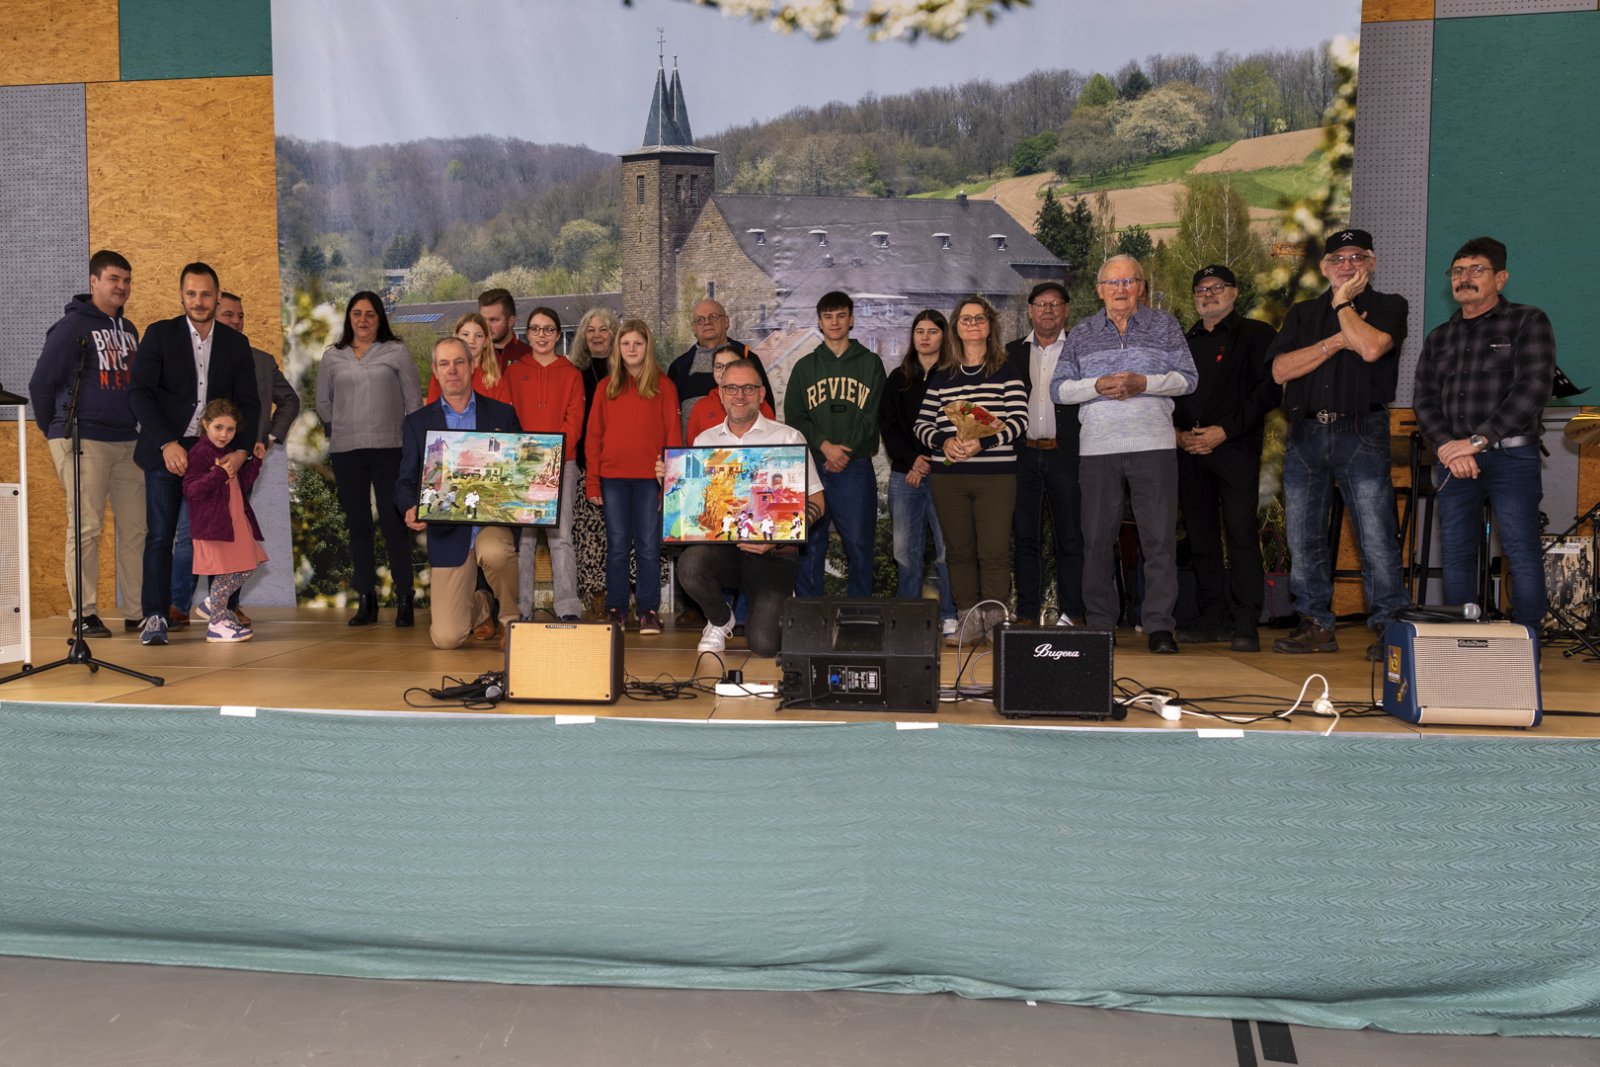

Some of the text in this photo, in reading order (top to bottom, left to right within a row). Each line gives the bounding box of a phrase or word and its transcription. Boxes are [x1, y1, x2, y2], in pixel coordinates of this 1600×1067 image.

[97, 350, 128, 371] NYC
[806, 376, 871, 410] REVIEW
[1033, 643, 1080, 660] Bugera
